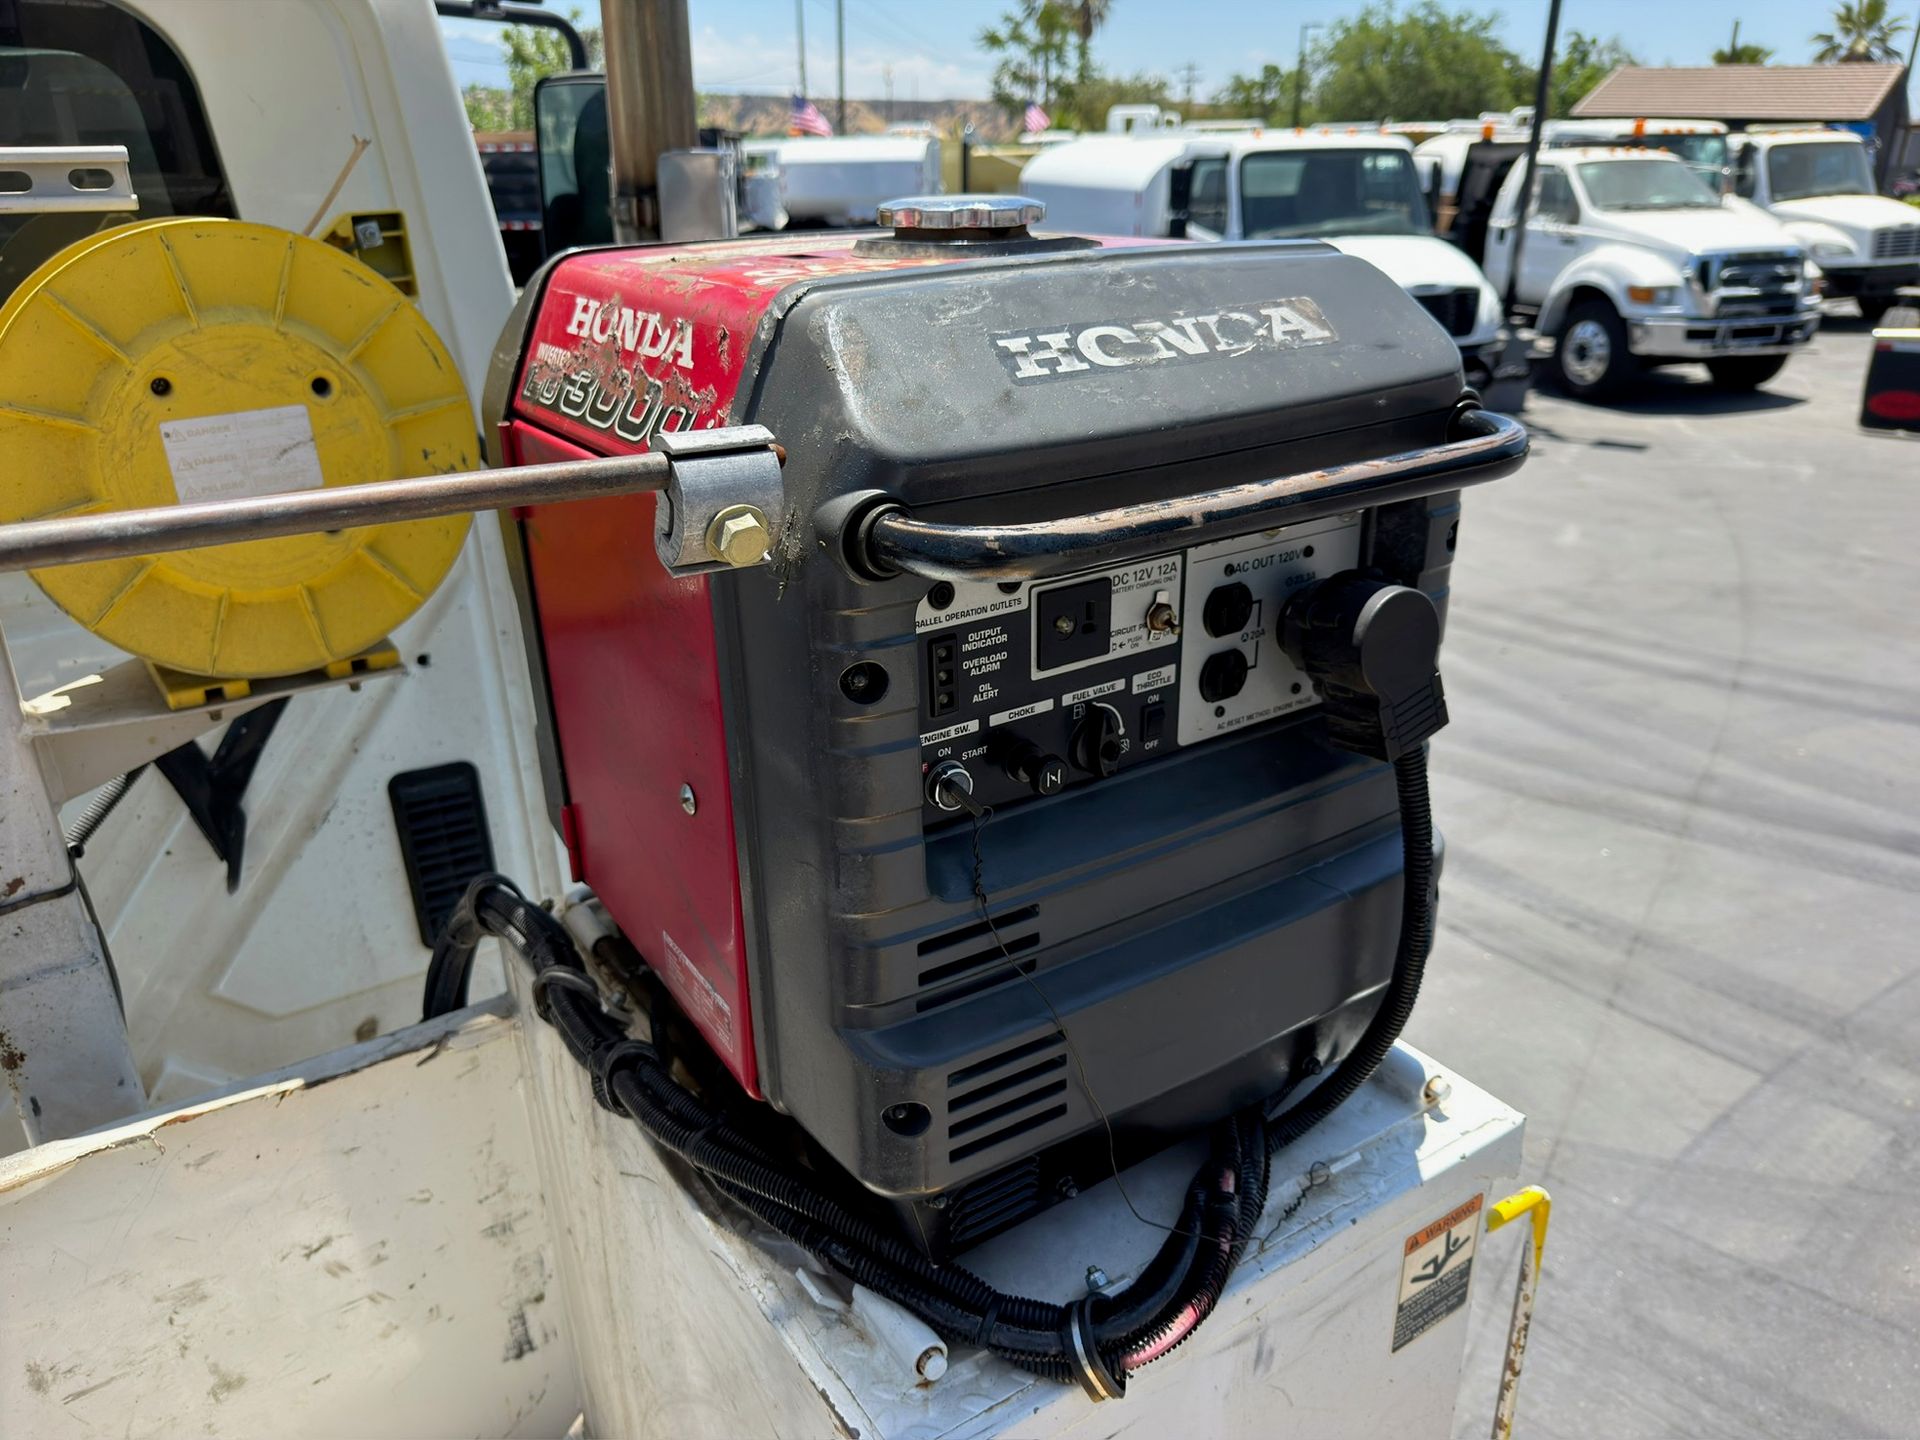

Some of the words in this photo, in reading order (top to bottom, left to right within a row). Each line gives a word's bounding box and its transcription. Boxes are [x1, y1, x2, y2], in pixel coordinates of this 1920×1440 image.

[566, 296, 694, 370] HONDA
[996, 306, 1331, 378] HONDA
[1234, 561, 1250, 574] AC
[1252, 555, 1275, 569] OUT
[1112, 572, 1129, 587] DC
[1133, 566, 1154, 582] 12V
[1158, 561, 1178, 576] 12A
[1136, 578, 1162, 591] CHARGING
[1164, 574, 1177, 583] ONLY
[945, 606, 988, 622] OPERATION
[990, 598, 1022, 611] OUTLETS
[968, 627, 1002, 642] OUTPUT
[1110, 624, 1137, 637] CIRCUIT
[962, 634, 1008, 652] INDICATOR
[962, 651, 1008, 670] OVERLOAD
[970, 662, 1001, 676] ALARM
[1147, 671, 1162, 681] ECO
[979, 683, 993, 694] OIL
[1136, 676, 1172, 692] THROTTLE
[972, 689, 999, 703] ALERT
[1072, 690, 1091, 702] FUEL
[1092, 683, 1116, 698] VALVE
[1147, 694, 1160, 704] ON
[1008, 705, 1036, 719] CHOKE
[954, 724, 971, 735] SW.
[937, 746, 952, 758] ON
[962, 745, 988, 760] START
[1145, 739, 1159, 751] OFF
[1425, 1201, 1476, 1239] WARNING
